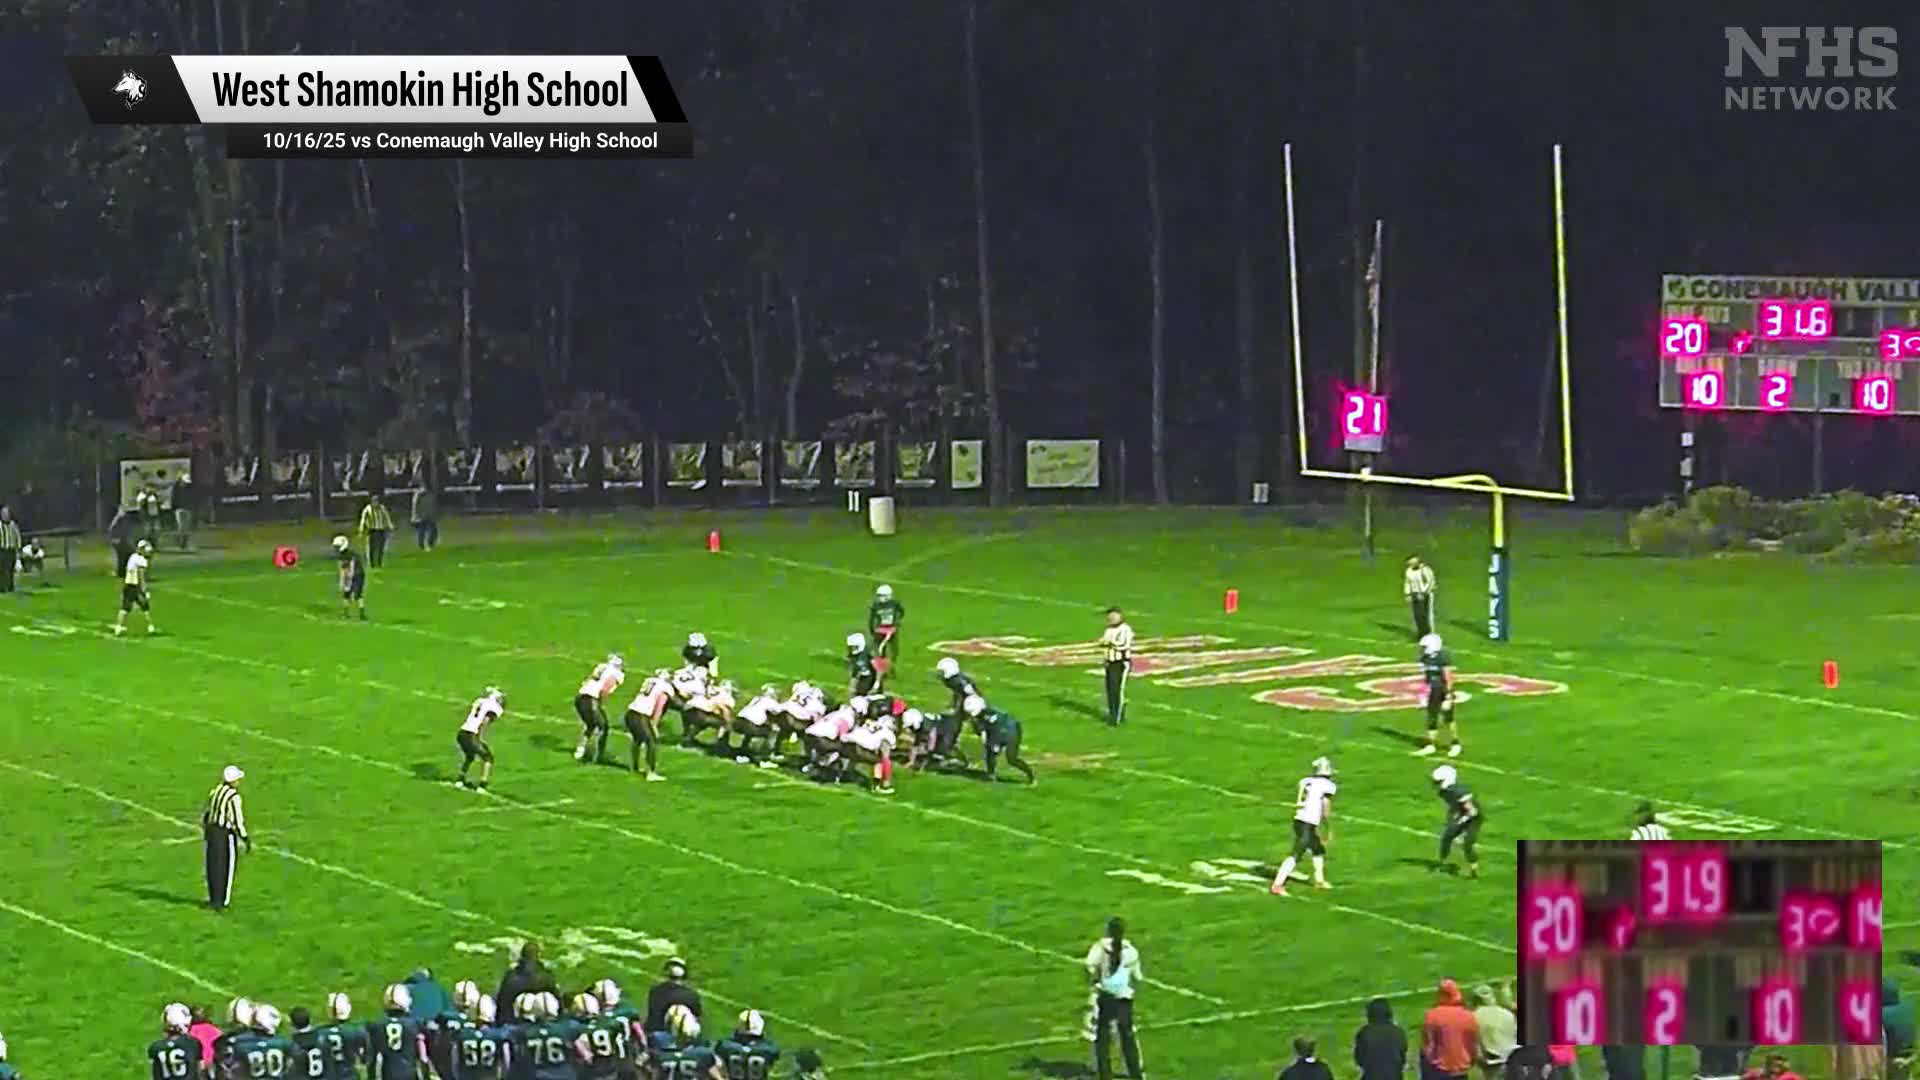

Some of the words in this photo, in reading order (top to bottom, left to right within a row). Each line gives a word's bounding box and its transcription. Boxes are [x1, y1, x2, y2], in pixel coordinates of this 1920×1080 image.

[1690, 278, 1847, 300] CONEMAUGH
[1856, 282, 1920, 301] VALL
[1665, 322, 1702, 355] 20
[1692, 373, 1719, 406] 10
[1767, 376, 1787, 407] 2
[1863, 379, 1889, 411] 10
[1346, 396, 1382, 434] 21
[1487, 552, 1501, 640] JAYS
[386, 1023, 403, 1051] 8
[527, 1038, 565, 1065] 76
[158, 1048, 187, 1079] 16
[308, 1048, 323, 1077] 6
